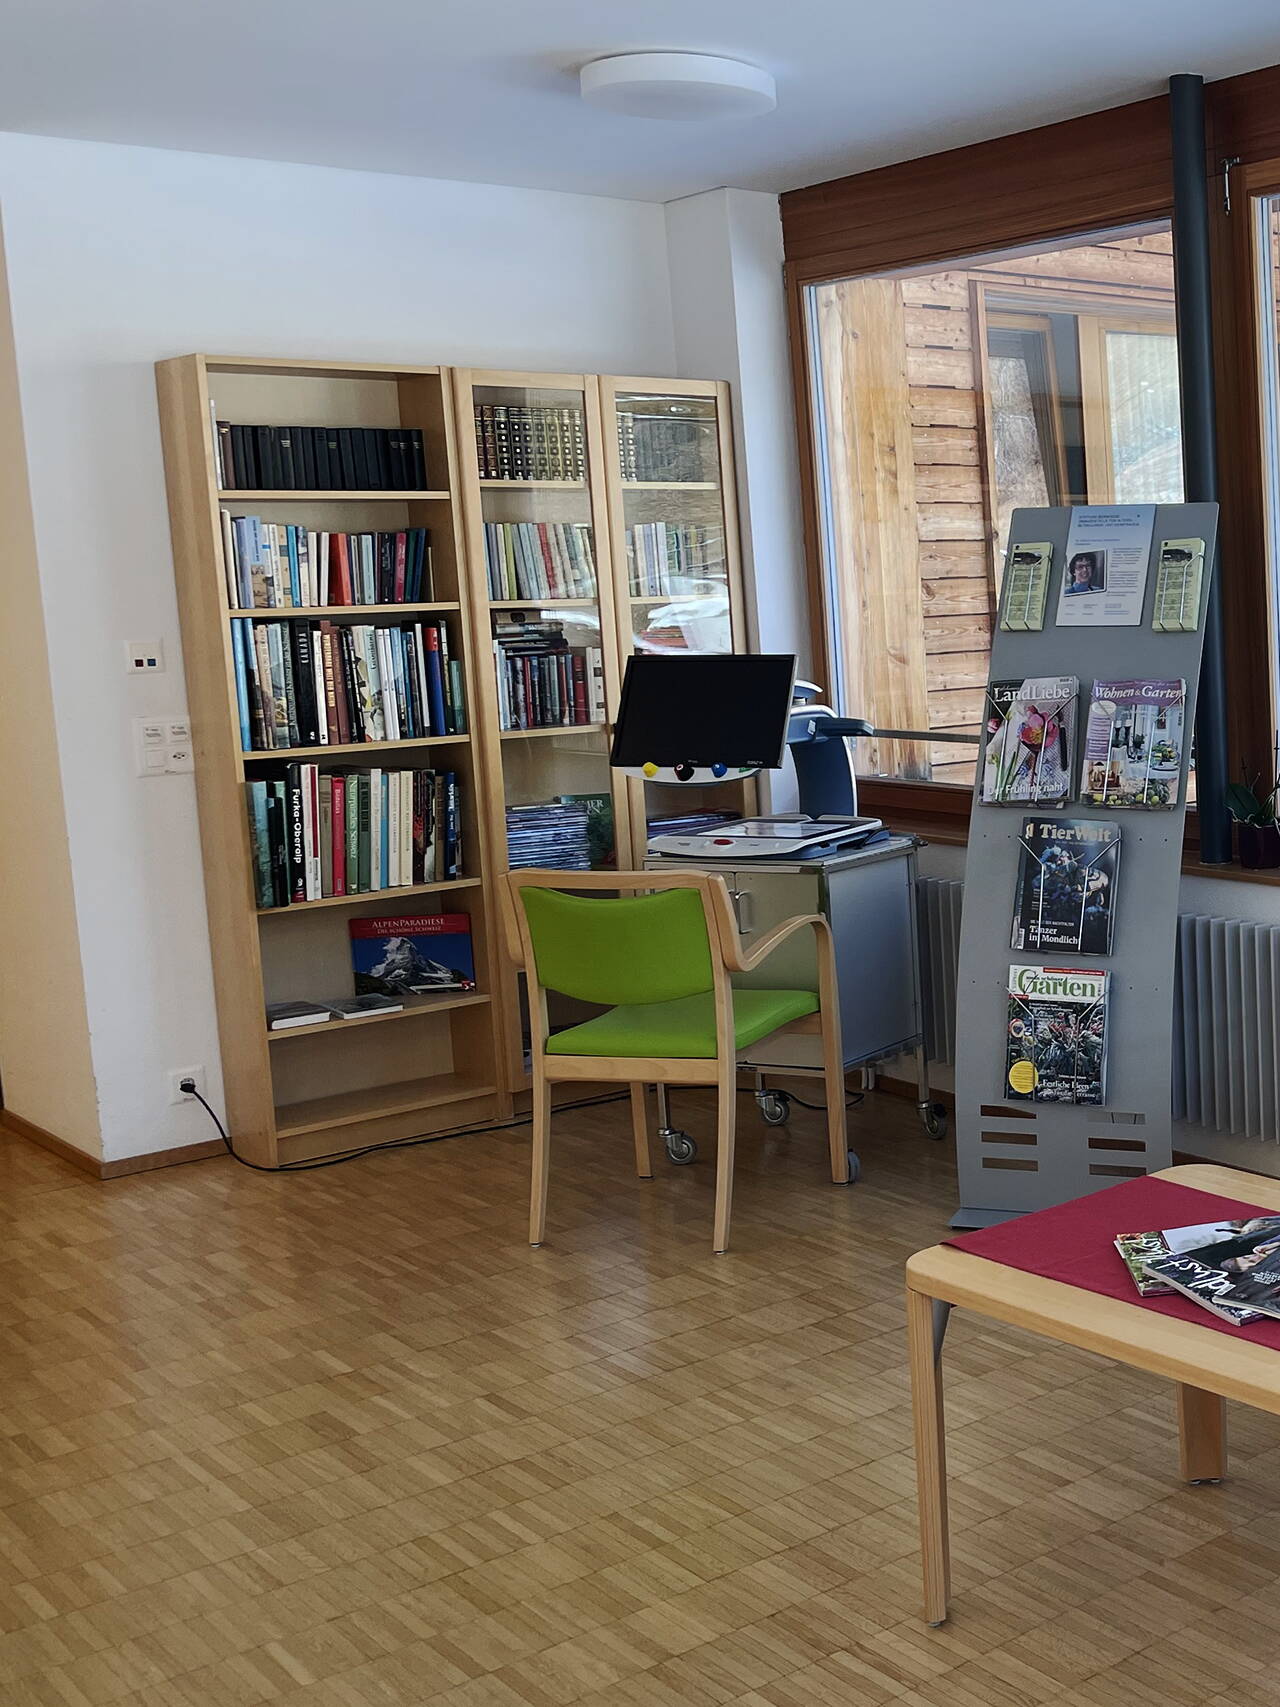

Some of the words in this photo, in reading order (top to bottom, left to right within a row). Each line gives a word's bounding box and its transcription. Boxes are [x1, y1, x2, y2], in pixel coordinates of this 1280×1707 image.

[1095, 686, 1136, 699] Wohnen
[291, 788, 303, 864] Furka-Oberalp
[1016, 968, 1096, 998] Garten
